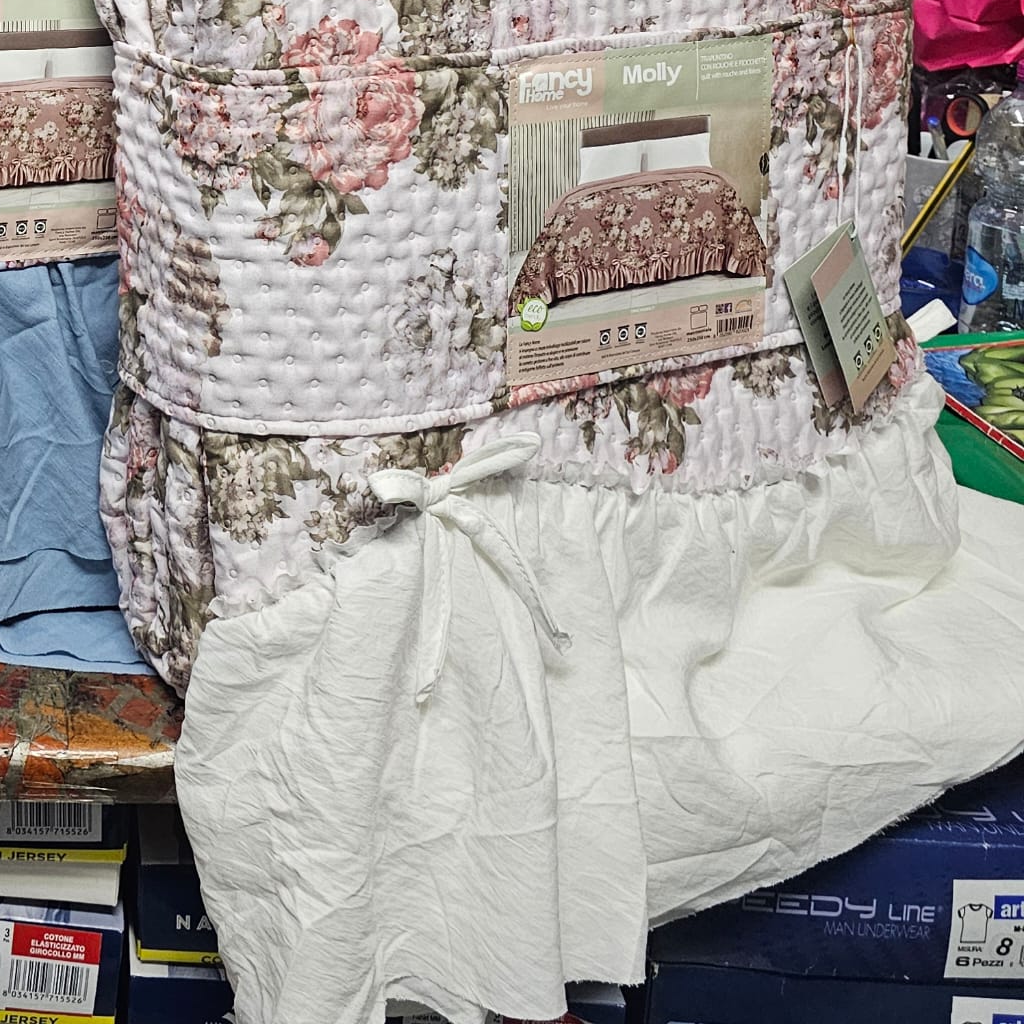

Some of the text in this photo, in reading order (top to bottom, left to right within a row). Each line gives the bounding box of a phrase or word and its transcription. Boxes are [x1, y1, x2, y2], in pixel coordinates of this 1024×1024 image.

[519, 62, 682, 103] Fancy Molly
[528, 89, 564, 103] Home
[7, 852, 67, 862] JERSEY
[741, 892, 935, 922] EEDY LINE
[4, 928, 10, 938] 3
[824, 921, 931, 939] MAN UNDERWEAR
[43, 933, 74, 942] COTONE
[31, 939, 86, 952] ELASTICIZZATO
[996, 937, 1014, 956] 8
[29, 948, 85, 960] GIROCOLLO MM
[955, 956, 1004, 967] 6 Pezzi
[0, 1015, 59, 1024] JERSEY
